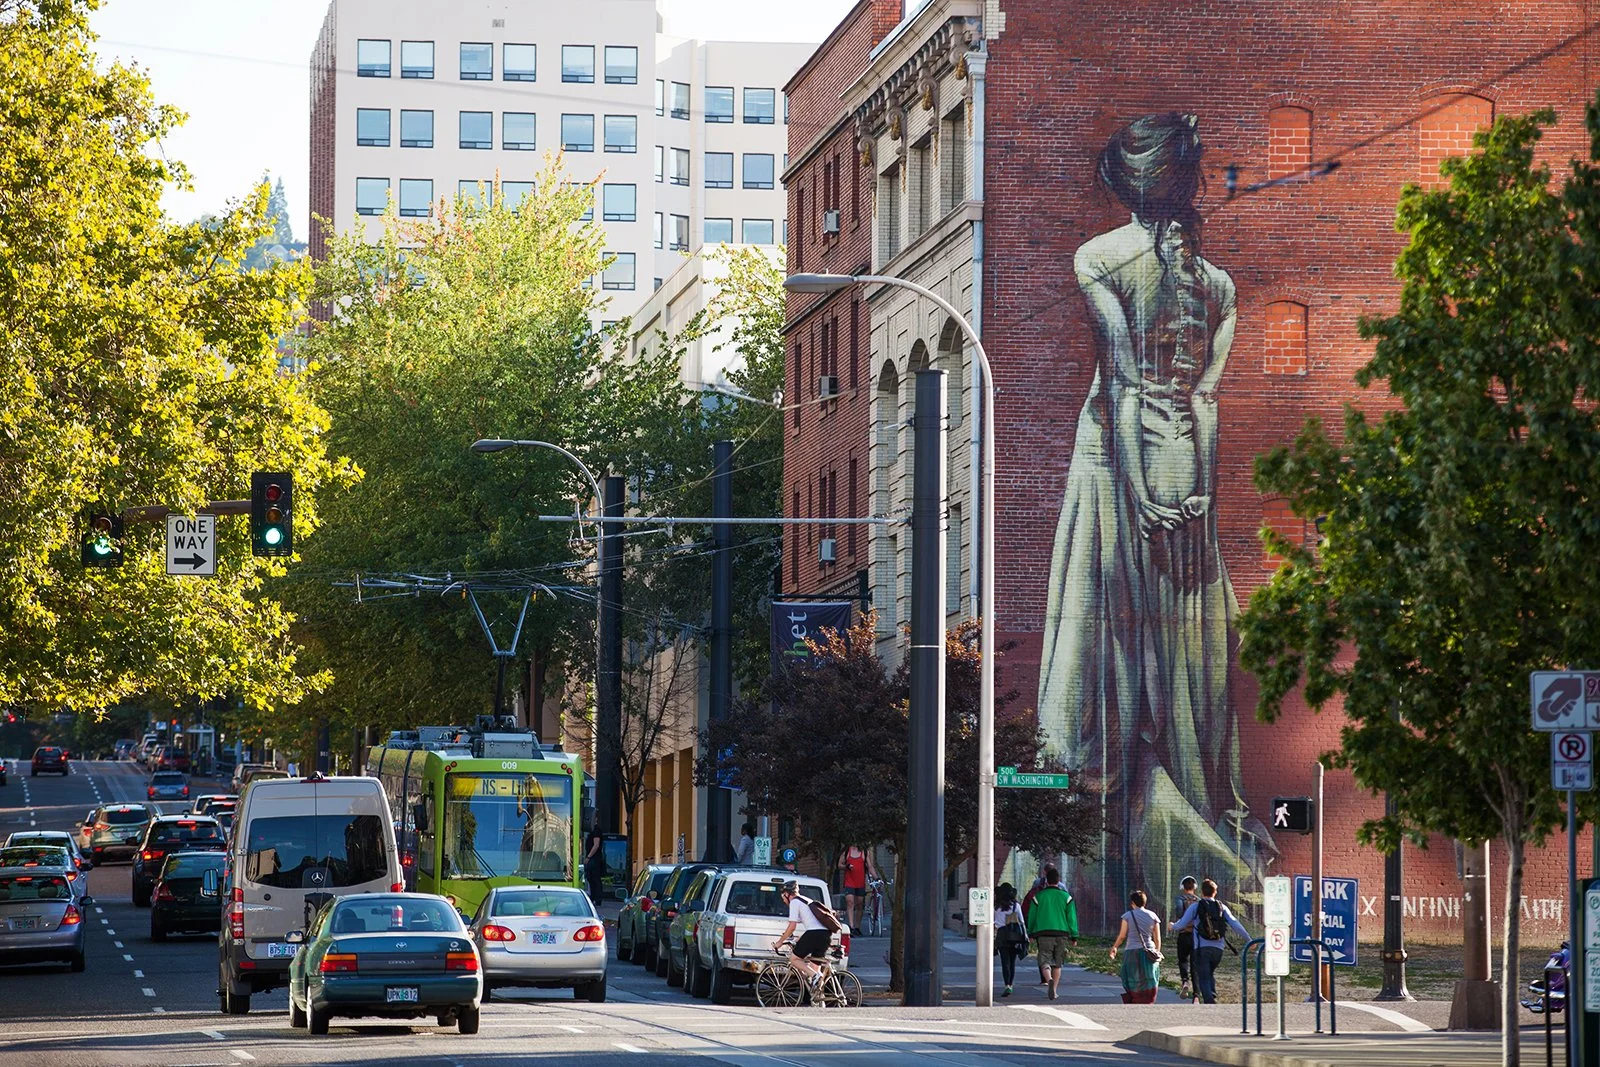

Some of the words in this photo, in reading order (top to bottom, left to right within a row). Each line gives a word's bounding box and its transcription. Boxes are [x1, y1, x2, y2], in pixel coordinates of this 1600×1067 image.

[175, 520, 207, 533] ONE
[174, 536, 208, 549] WAY
[784, 611, 809, 663] het
[502, 761, 517, 770] 009
[1001, 767, 1014, 775] 500
[998, 775, 1009, 784] SW
[1011, 775, 1054, 785] WASHINGTON
[482, 779, 496, 795] NS
[1357, 896, 1377, 917] X
[1403, 896, 1463, 919] NFINI
[1304, 913, 1345, 928] SCIAL
[1325, 937, 1344, 946] DAY
